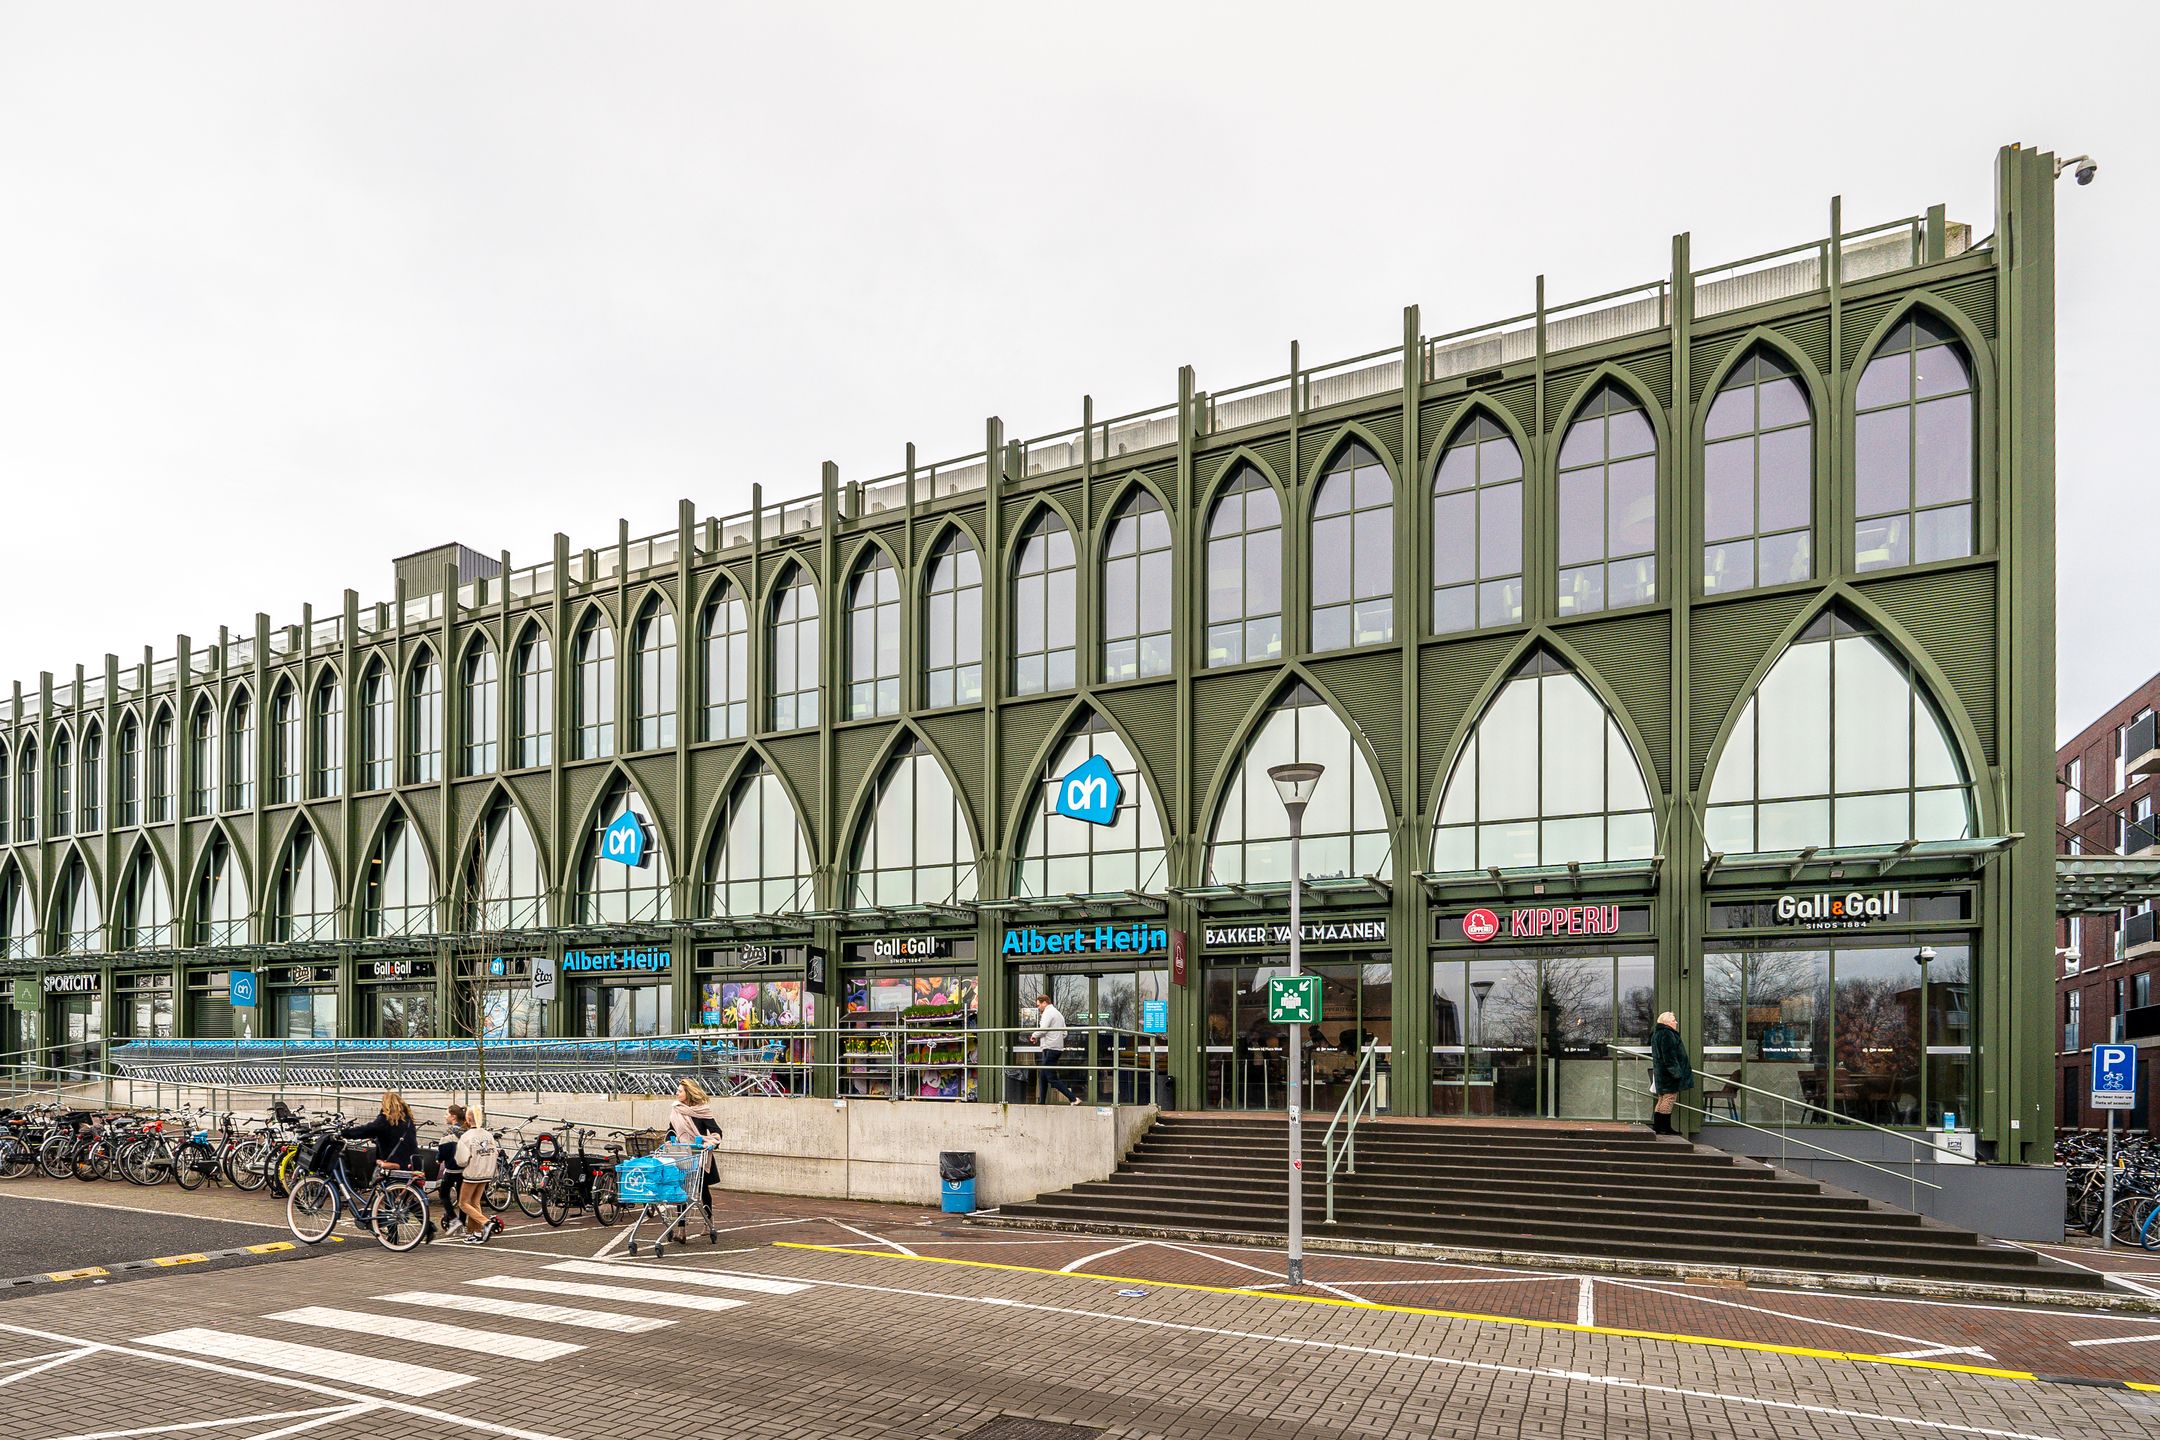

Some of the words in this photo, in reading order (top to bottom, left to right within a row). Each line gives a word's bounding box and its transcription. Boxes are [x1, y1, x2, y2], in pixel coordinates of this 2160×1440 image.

[1778, 890, 1899, 918] Gall&Gall
[1205, 927, 1266, 944] BAKKER
[1273, 926, 1307, 941] VAN
[1312, 922, 1385, 939] MAANEN
[1512, 905, 1619, 937] KIPPERIJ
[874, 936, 935, 955] Gall&Gall
[1002, 929, 1085, 953] Albert
[1095, 924, 1167, 955] Heijn
[562, 949, 617, 971] Albert
[623, 947, 670, 972] Heijn
[534, 968, 553, 982] Etos
[2103, 1049, 2126, 1072] P
